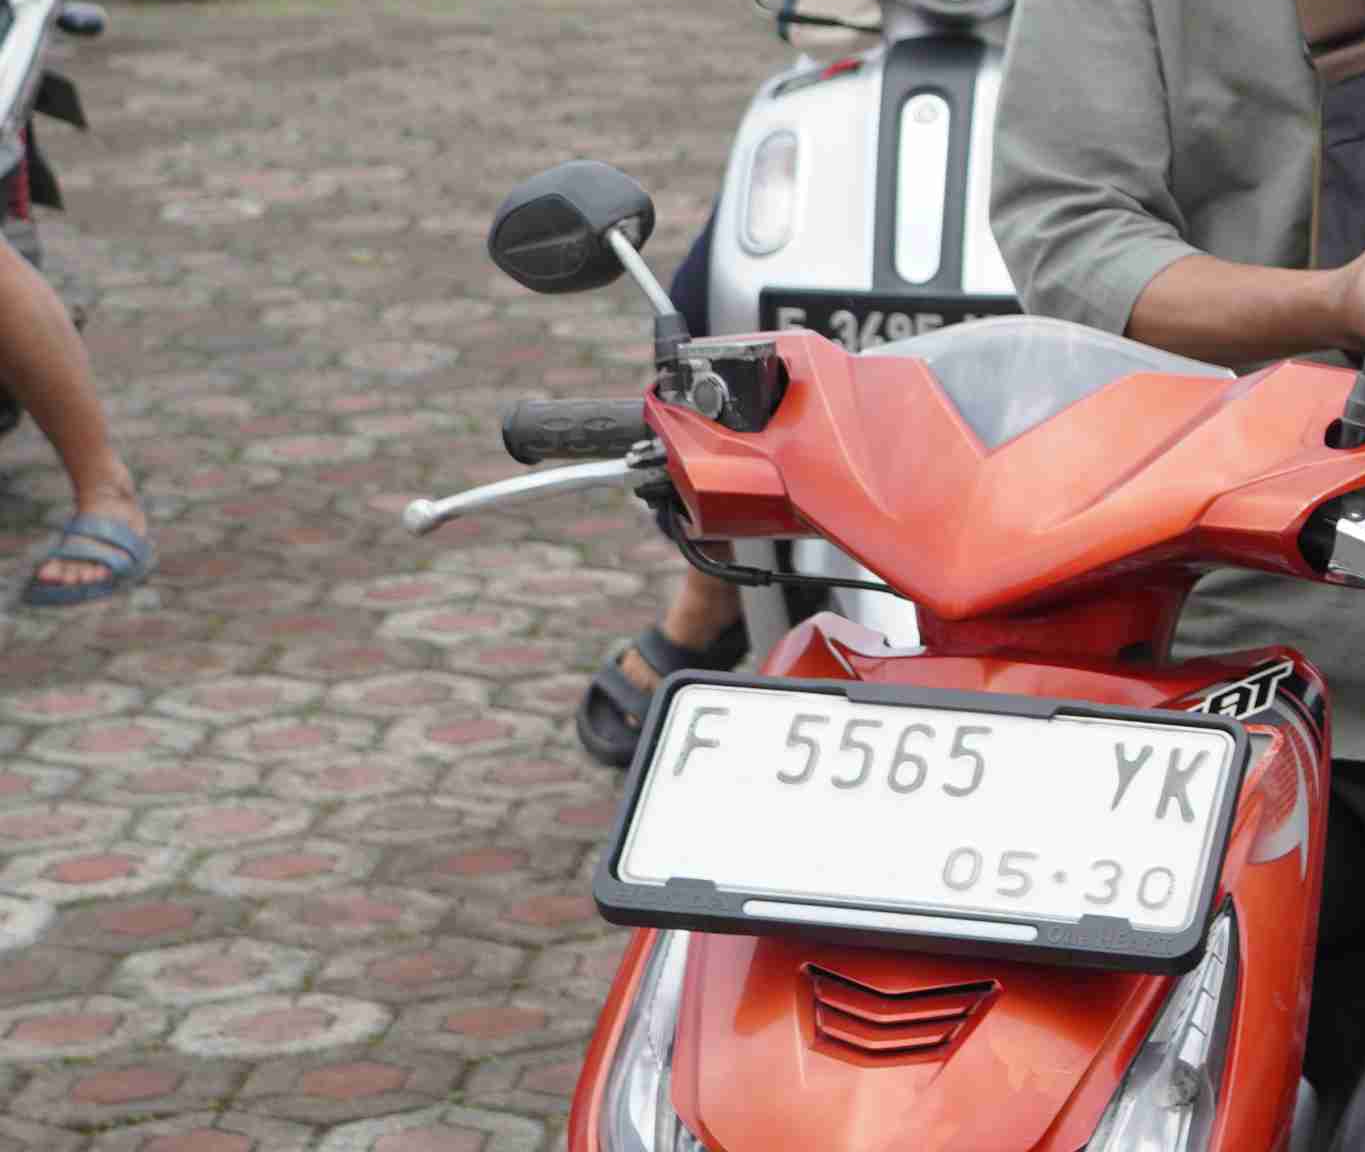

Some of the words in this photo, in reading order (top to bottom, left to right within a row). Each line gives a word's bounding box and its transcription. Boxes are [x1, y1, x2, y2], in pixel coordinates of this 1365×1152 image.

[1190, 659, 1295, 721] AT
[673, 705, 730, 777] F
[775, 713, 993, 798] 5565
[1111, 741, 1210, 823] YK
